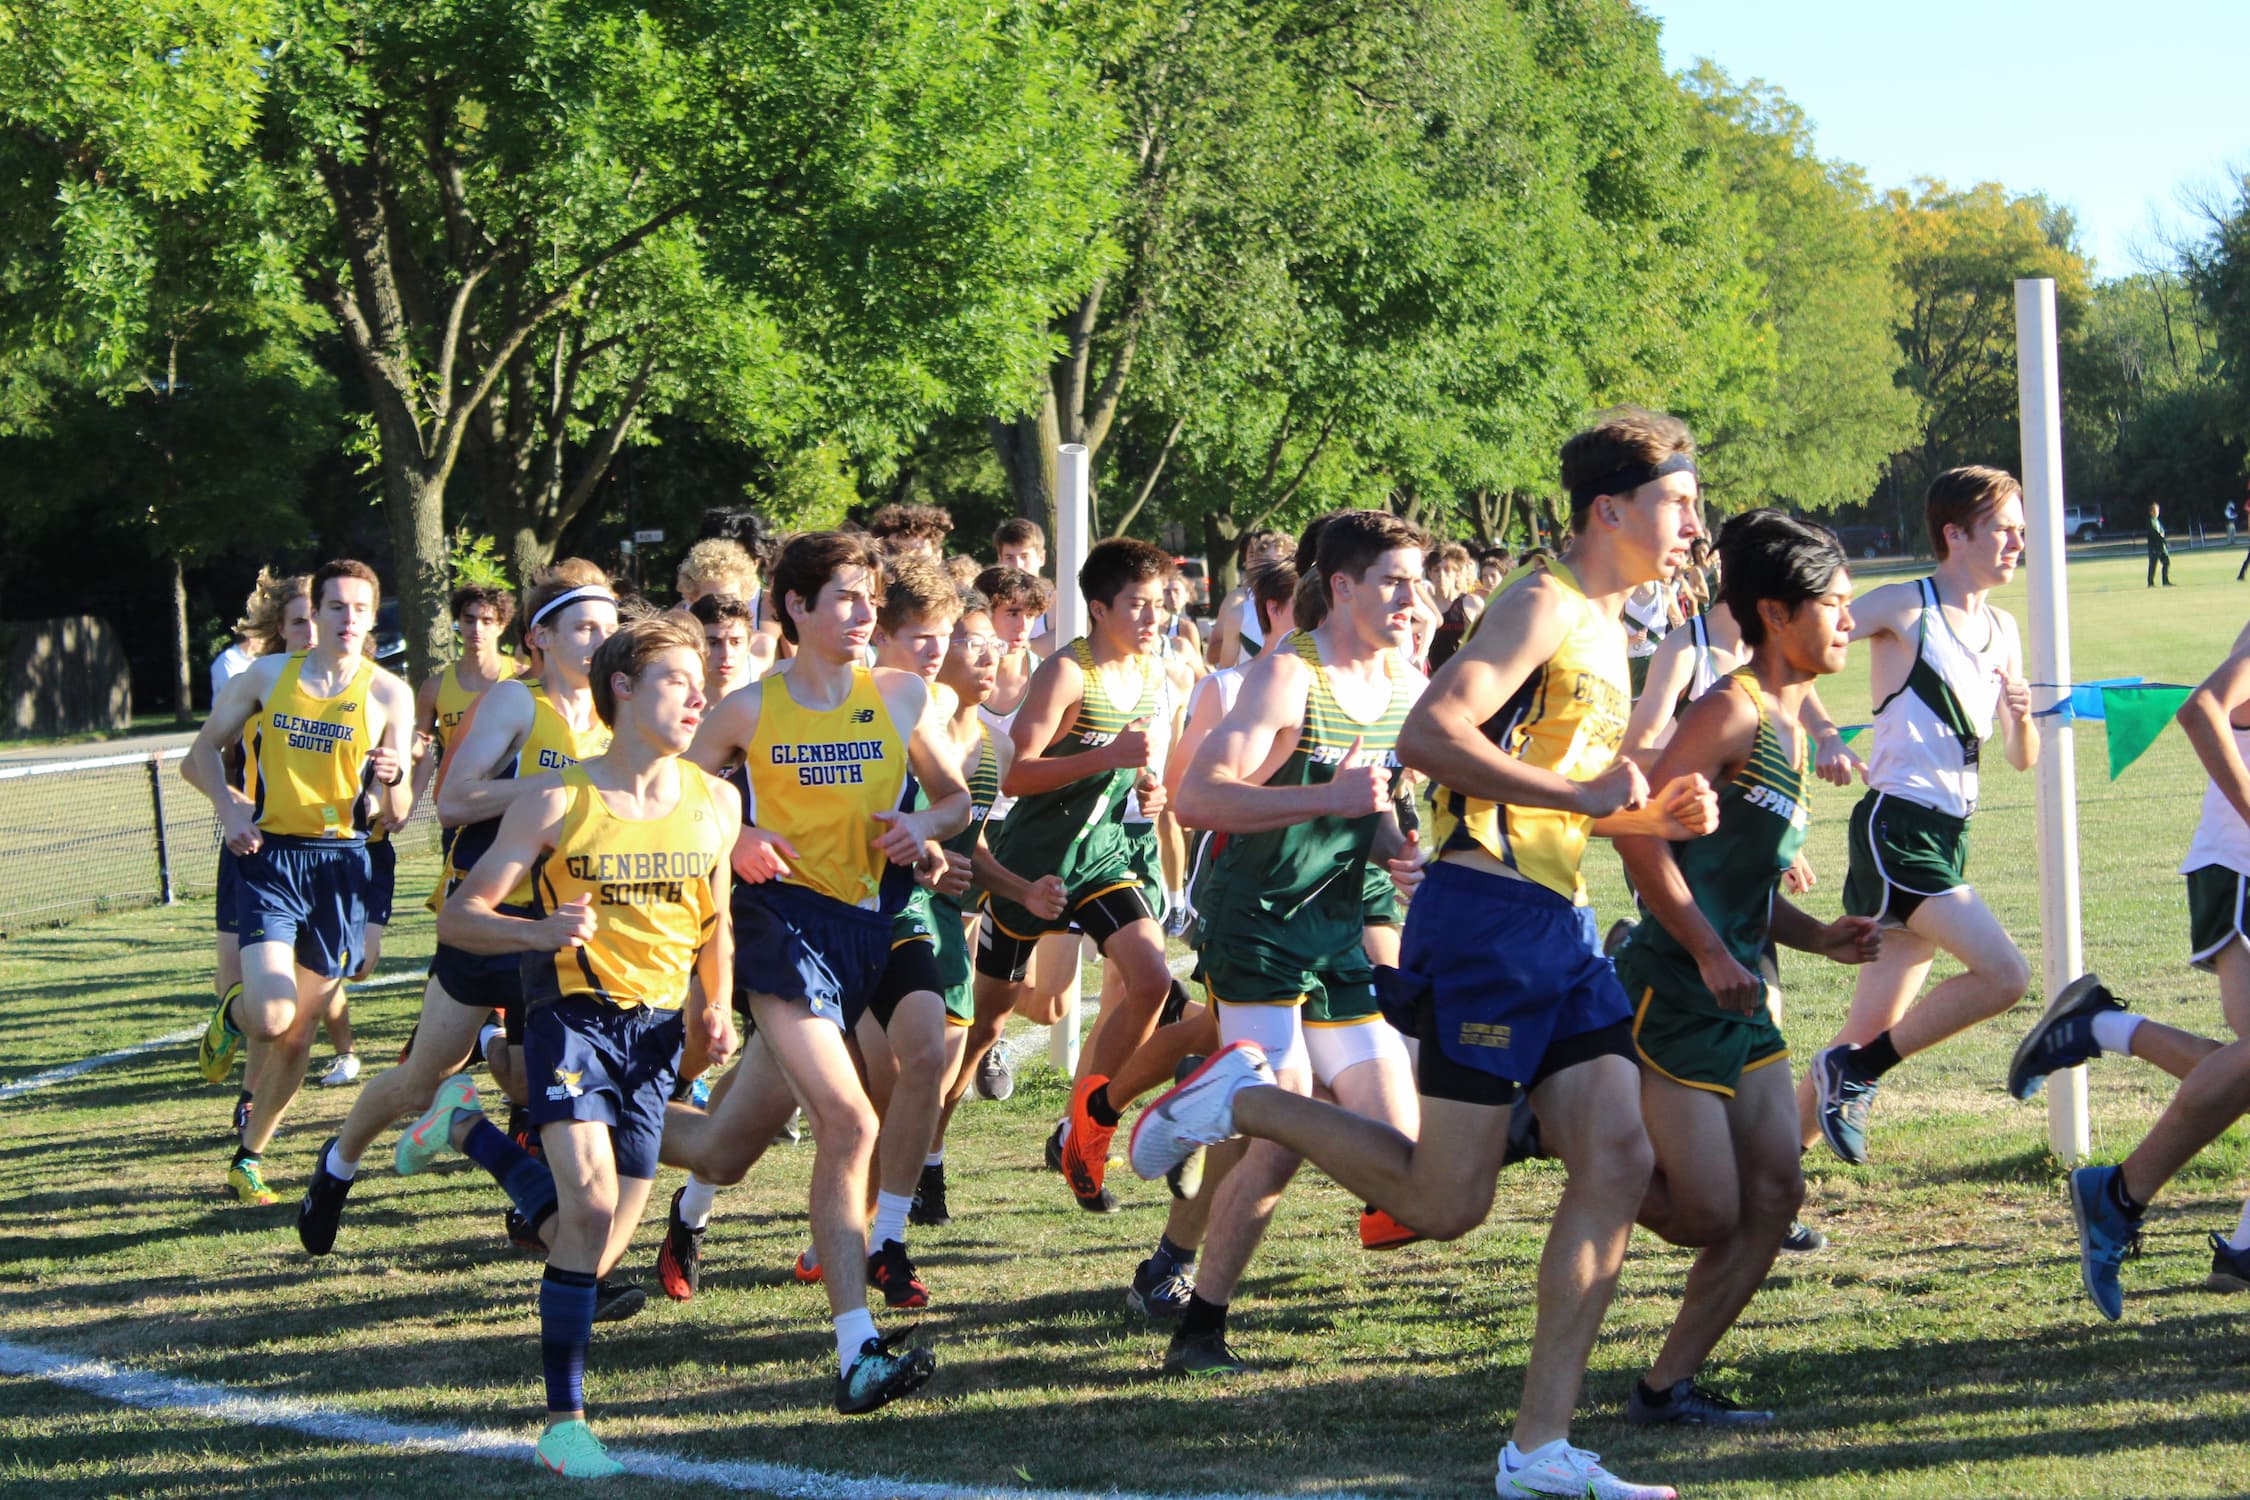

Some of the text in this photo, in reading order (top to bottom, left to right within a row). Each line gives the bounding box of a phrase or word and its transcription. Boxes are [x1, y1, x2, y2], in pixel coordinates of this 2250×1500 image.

[273, 713, 354, 741] GLENBROOK
[288, 733, 334, 754] SOUTH
[771, 740, 884, 765] GLENBROOK
[799, 764, 863, 786] SOUTH
[600, 881, 684, 905] SOUTH
